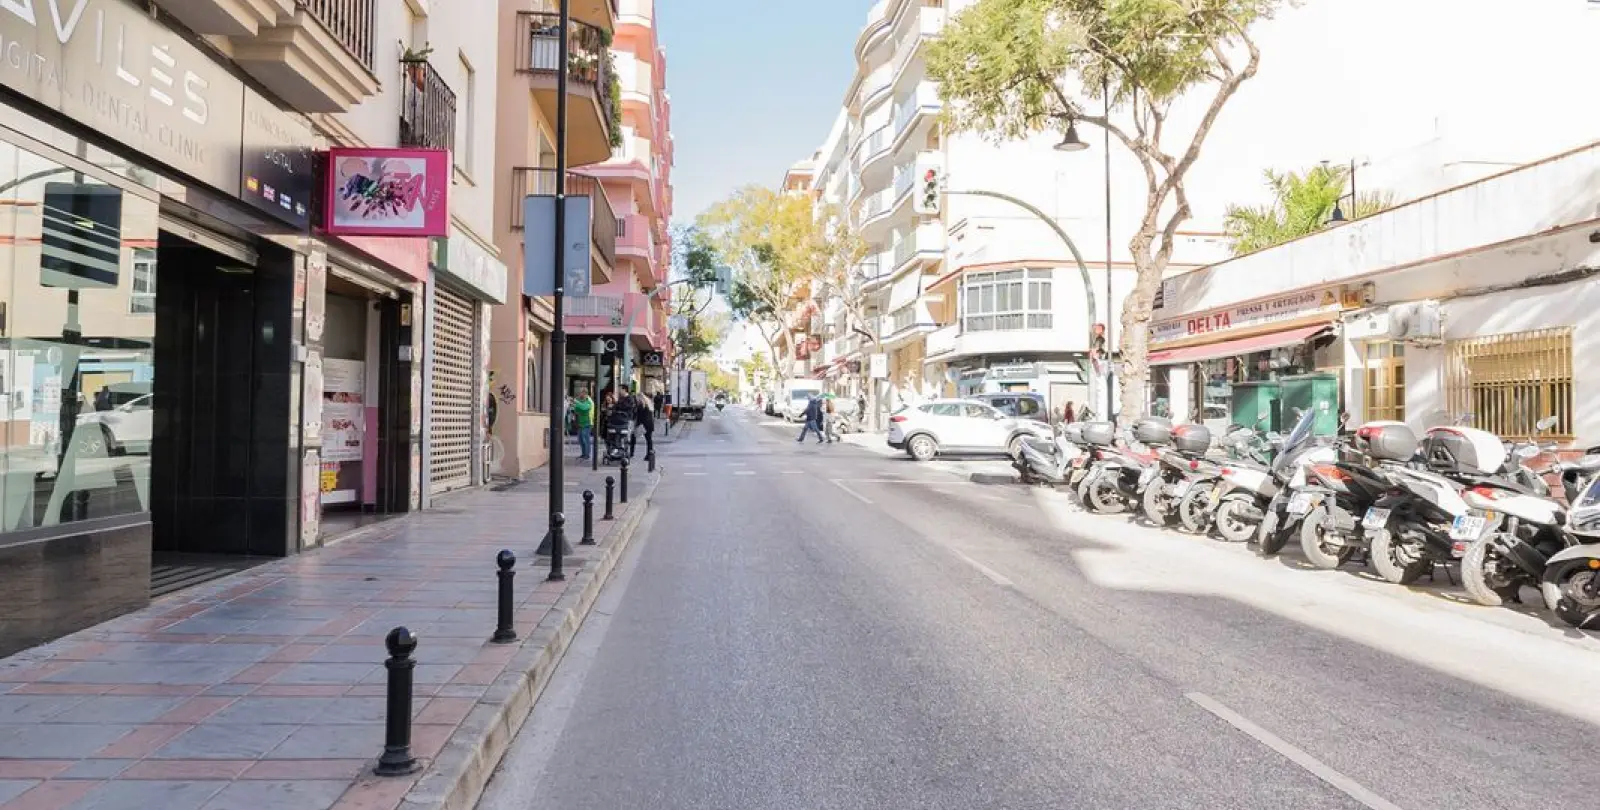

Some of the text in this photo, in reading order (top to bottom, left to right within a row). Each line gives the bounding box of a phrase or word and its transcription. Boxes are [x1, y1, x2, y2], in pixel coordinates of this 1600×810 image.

[83, 81, 152, 138] DENTAL
[159, 124, 204, 164] CLINIC
[1187, 311, 1231, 335] DELTA
